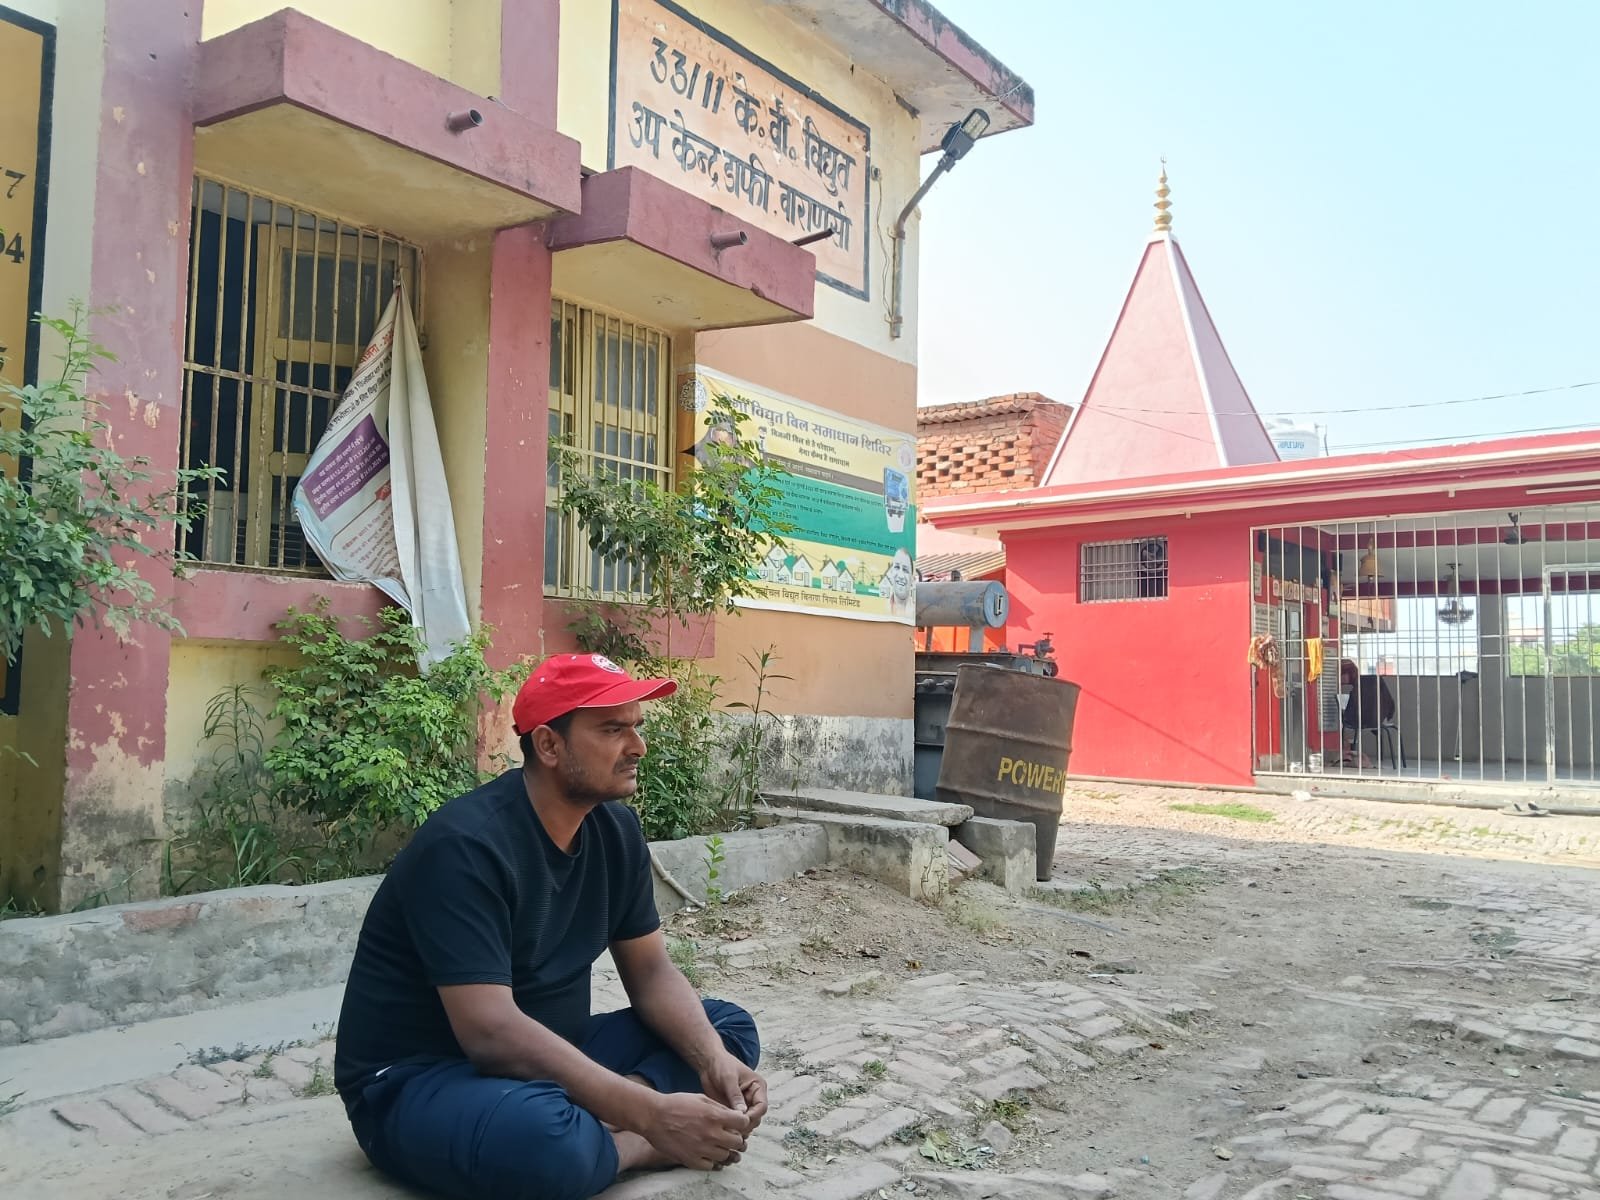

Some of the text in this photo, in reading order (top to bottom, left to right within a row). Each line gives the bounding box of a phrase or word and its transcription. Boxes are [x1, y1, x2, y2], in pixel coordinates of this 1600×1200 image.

[628, 101, 667, 160] उप
[803, 115, 856, 197] विद्युत
[752, 400, 783, 426] विद्युत
[786, 411, 809, 432] बिल
[812, 423, 859, 446] समाधान
[861, 433, 892, 456] शिविर
[782, 587, 799, 602] विद्युत
